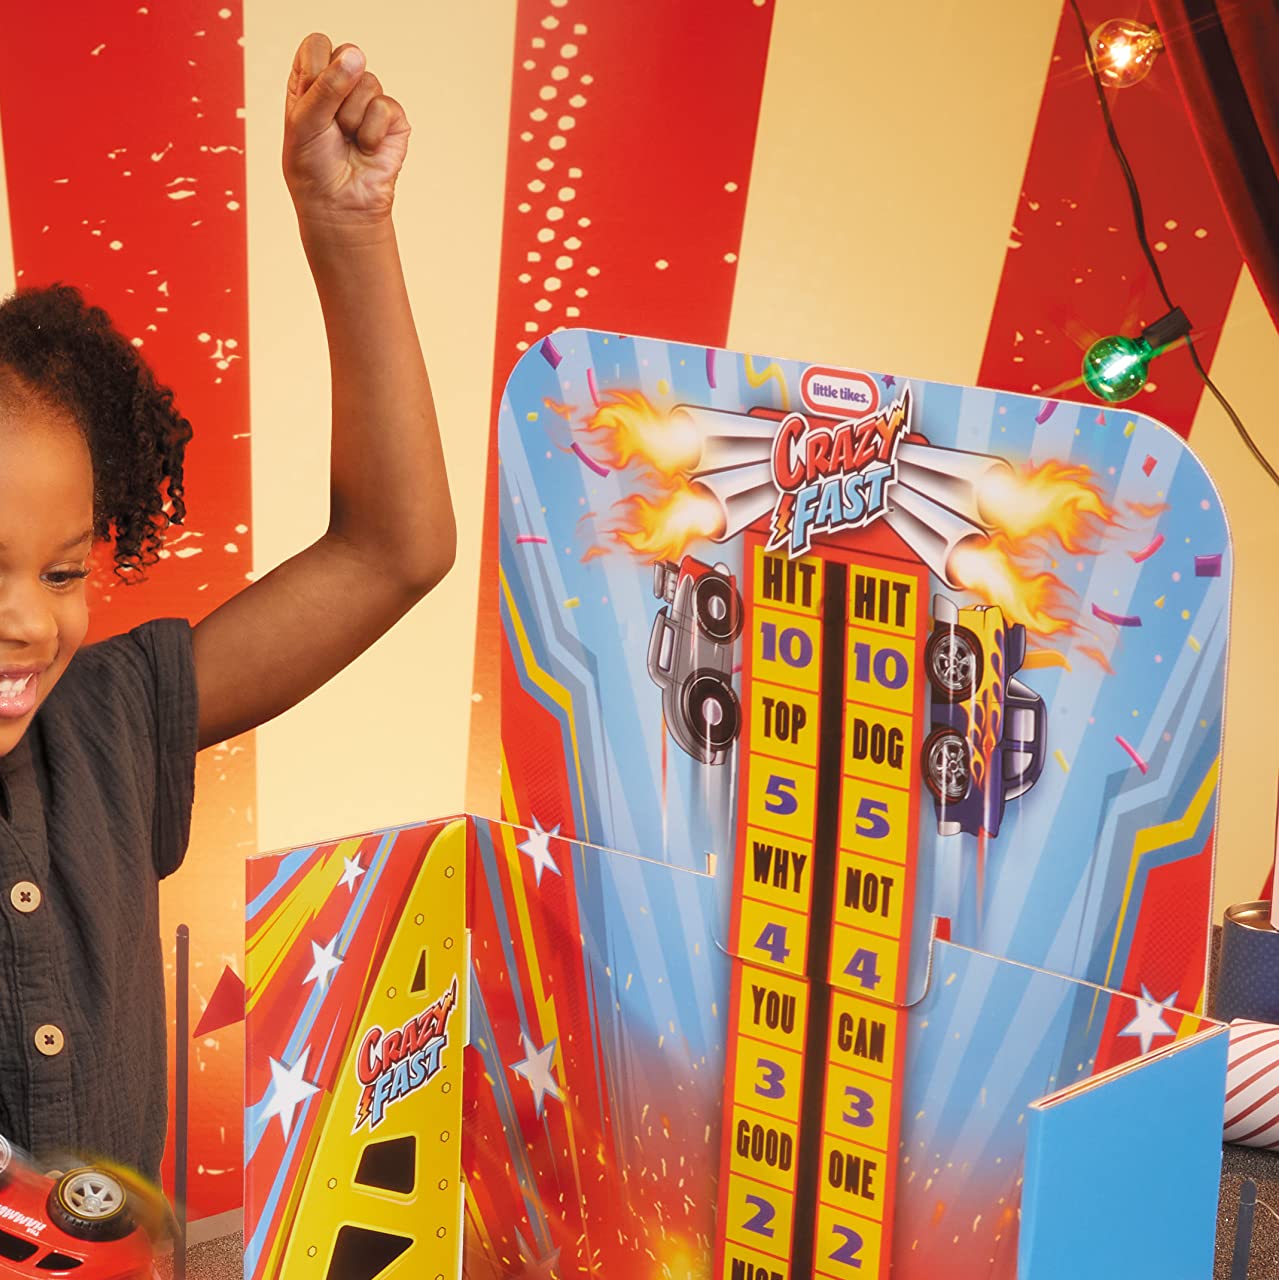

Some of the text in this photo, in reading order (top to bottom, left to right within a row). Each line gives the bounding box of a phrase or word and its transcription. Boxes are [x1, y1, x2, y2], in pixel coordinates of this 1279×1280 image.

[813, 382, 838, 399] little
[773, 395, 908, 491] CRAZY
[790, 465, 894, 552] FAST
[763, 555, 816, 608] HIT
[854, 574, 910, 628] HIT
[760, 621, 813, 670] 10
[854, 642, 909, 690] 10
[761, 696, 904, 770] TOP DOG
[764, 774, 799, 816] 5
[855, 797, 891, 839] 5
[752, 841, 894, 918] WHY NOT
[753, 922, 791, 964] 4
[843, 947, 881, 991] 4
[357, 980, 456, 1085] CRAZY
[751, 984, 887, 1063] YOU CAN
[370, 1036, 446, 1129] FAST
[754, 1057, 787, 1100] 3
[842, 1085, 875, 1128] 3
[736, 1119, 877, 1201] GOOD ONE
[741, 1193, 776, 1239] 2
[827, 1223, 864, 1269] 2
